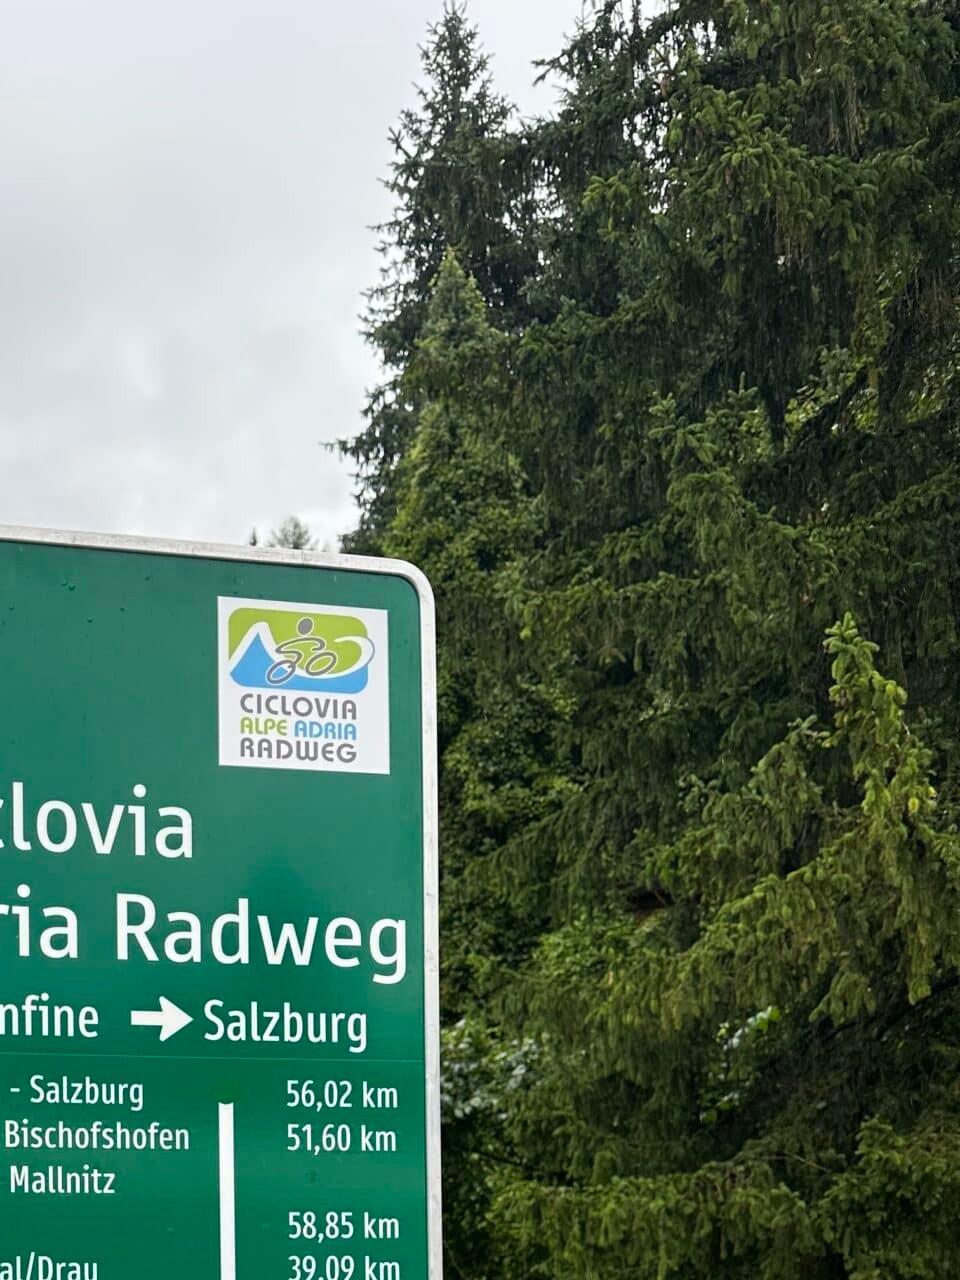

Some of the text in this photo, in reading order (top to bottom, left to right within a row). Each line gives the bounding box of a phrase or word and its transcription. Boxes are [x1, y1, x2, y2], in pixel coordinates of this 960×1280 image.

[241, 694, 356, 720] CICLOVIA
[241, 717, 356, 740] ALPE ADRIA
[241, 738, 356, 763] RADWEG
[117, 893, 406, 984] Radweg
[205, 1000, 366, 1052] Salzburg
[31, 1075, 143, 1111] Salzburg
[287, 1080, 397, 1111] 56,02 km
[5, 1119, 188, 1149] Bischofshofen
[288, 1124, 395, 1155] 51,60 km
[11, 1165, 115, 1193] Mallnitz
[289, 1212, 399, 1242] 58,85 km
[365, 1256, 399, 1280] km
